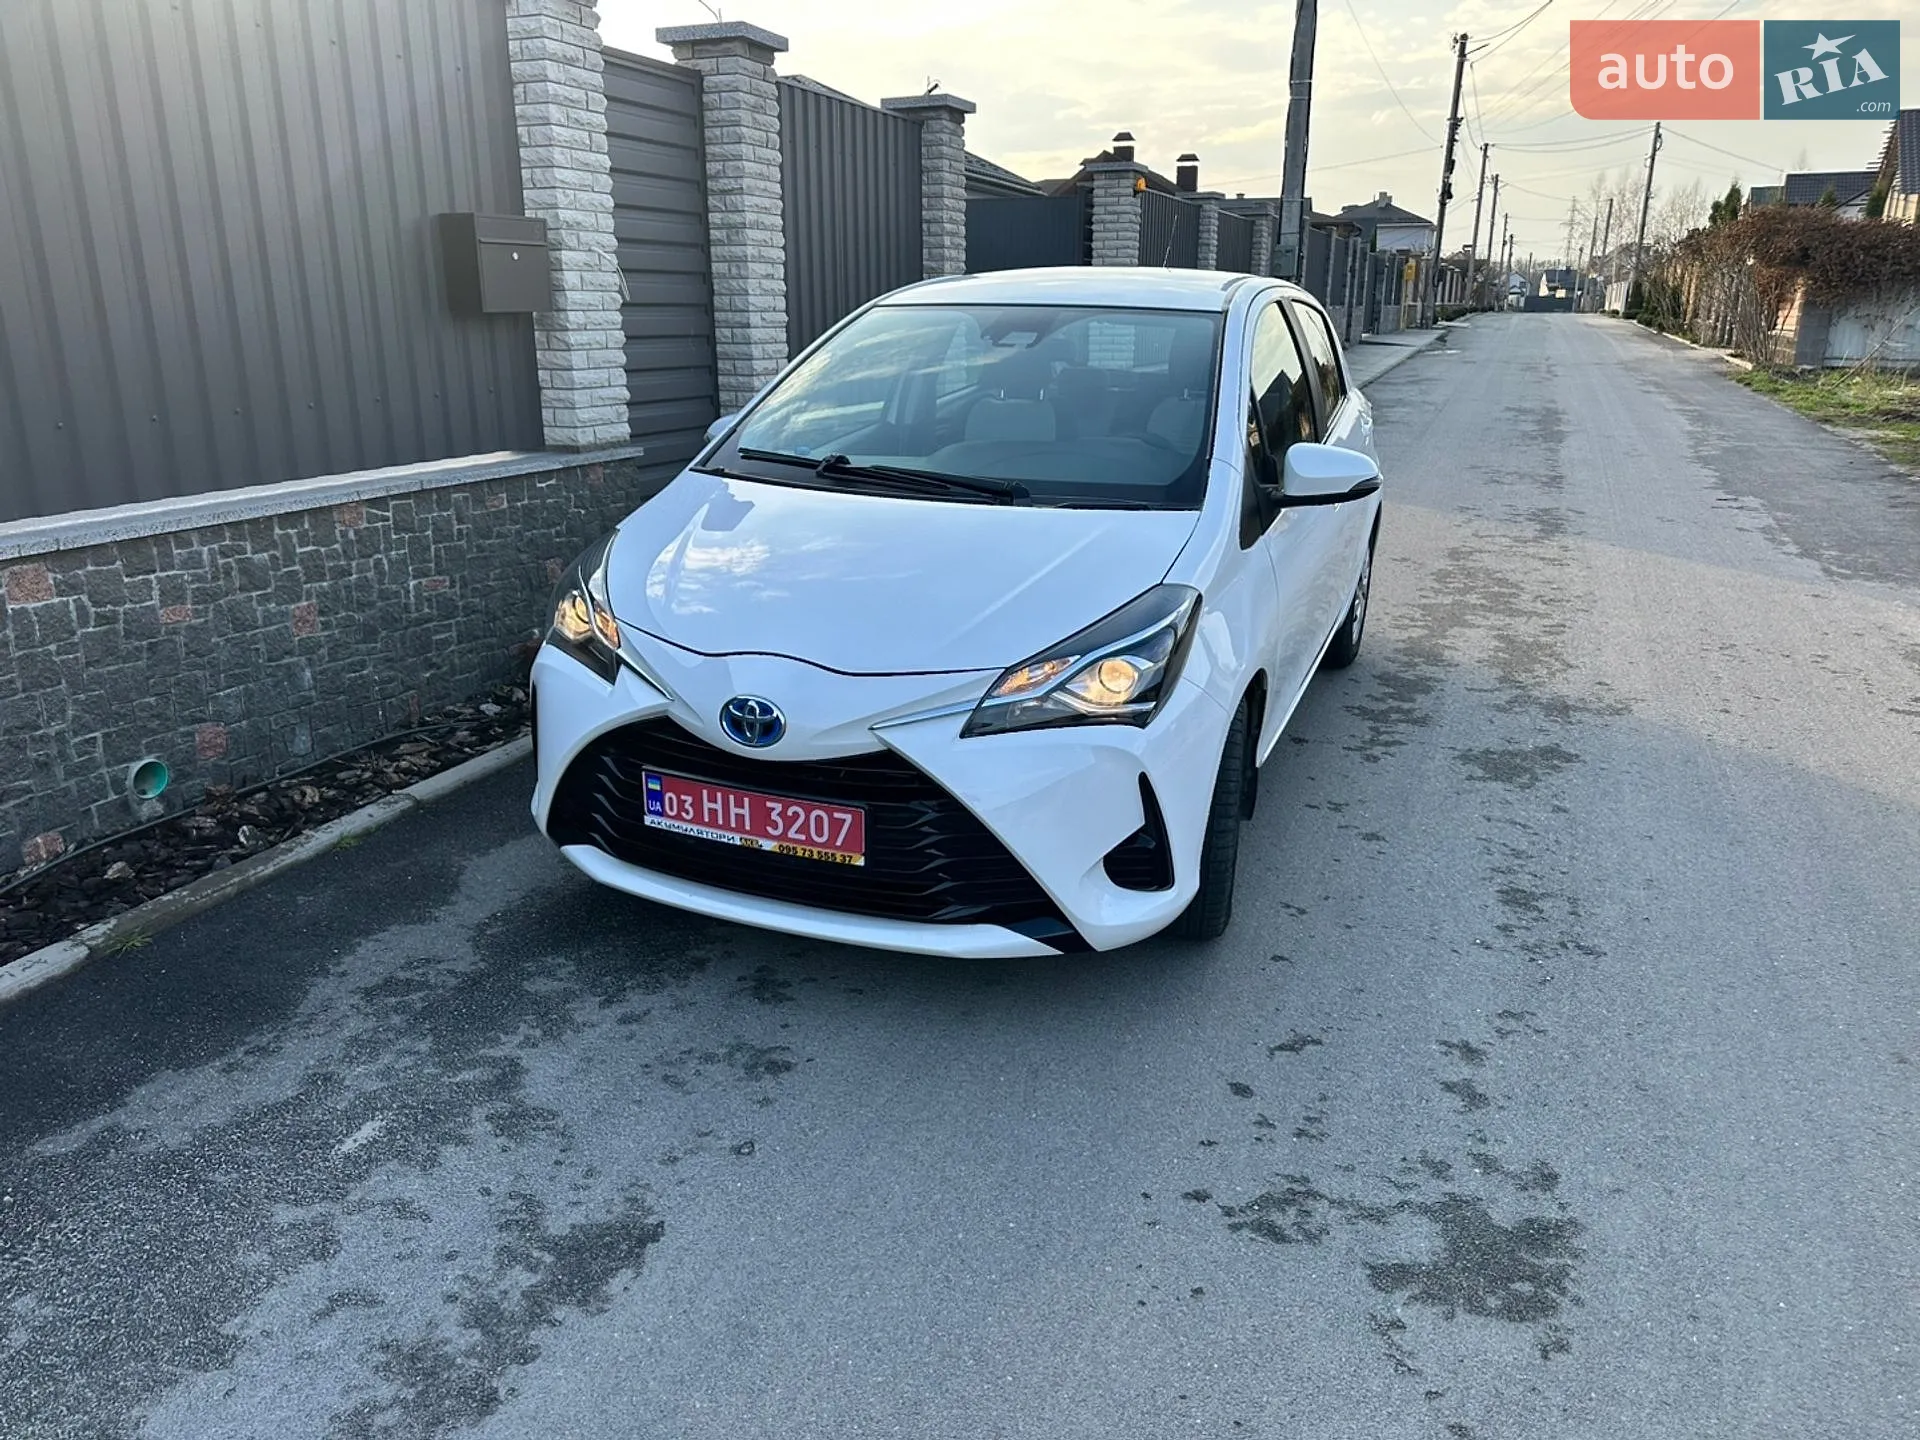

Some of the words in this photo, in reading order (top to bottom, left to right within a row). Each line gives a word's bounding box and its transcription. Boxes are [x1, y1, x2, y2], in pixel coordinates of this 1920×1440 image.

[648, 800, 662, 812] UA
[664, 791, 695, 820] 03
[702, 789, 751, 830] HH
[765, 800, 853, 847] 3207
[778, 843, 799, 854] 095
[800, 847, 815, 858] 73
[839, 853, 854, 864] 37
